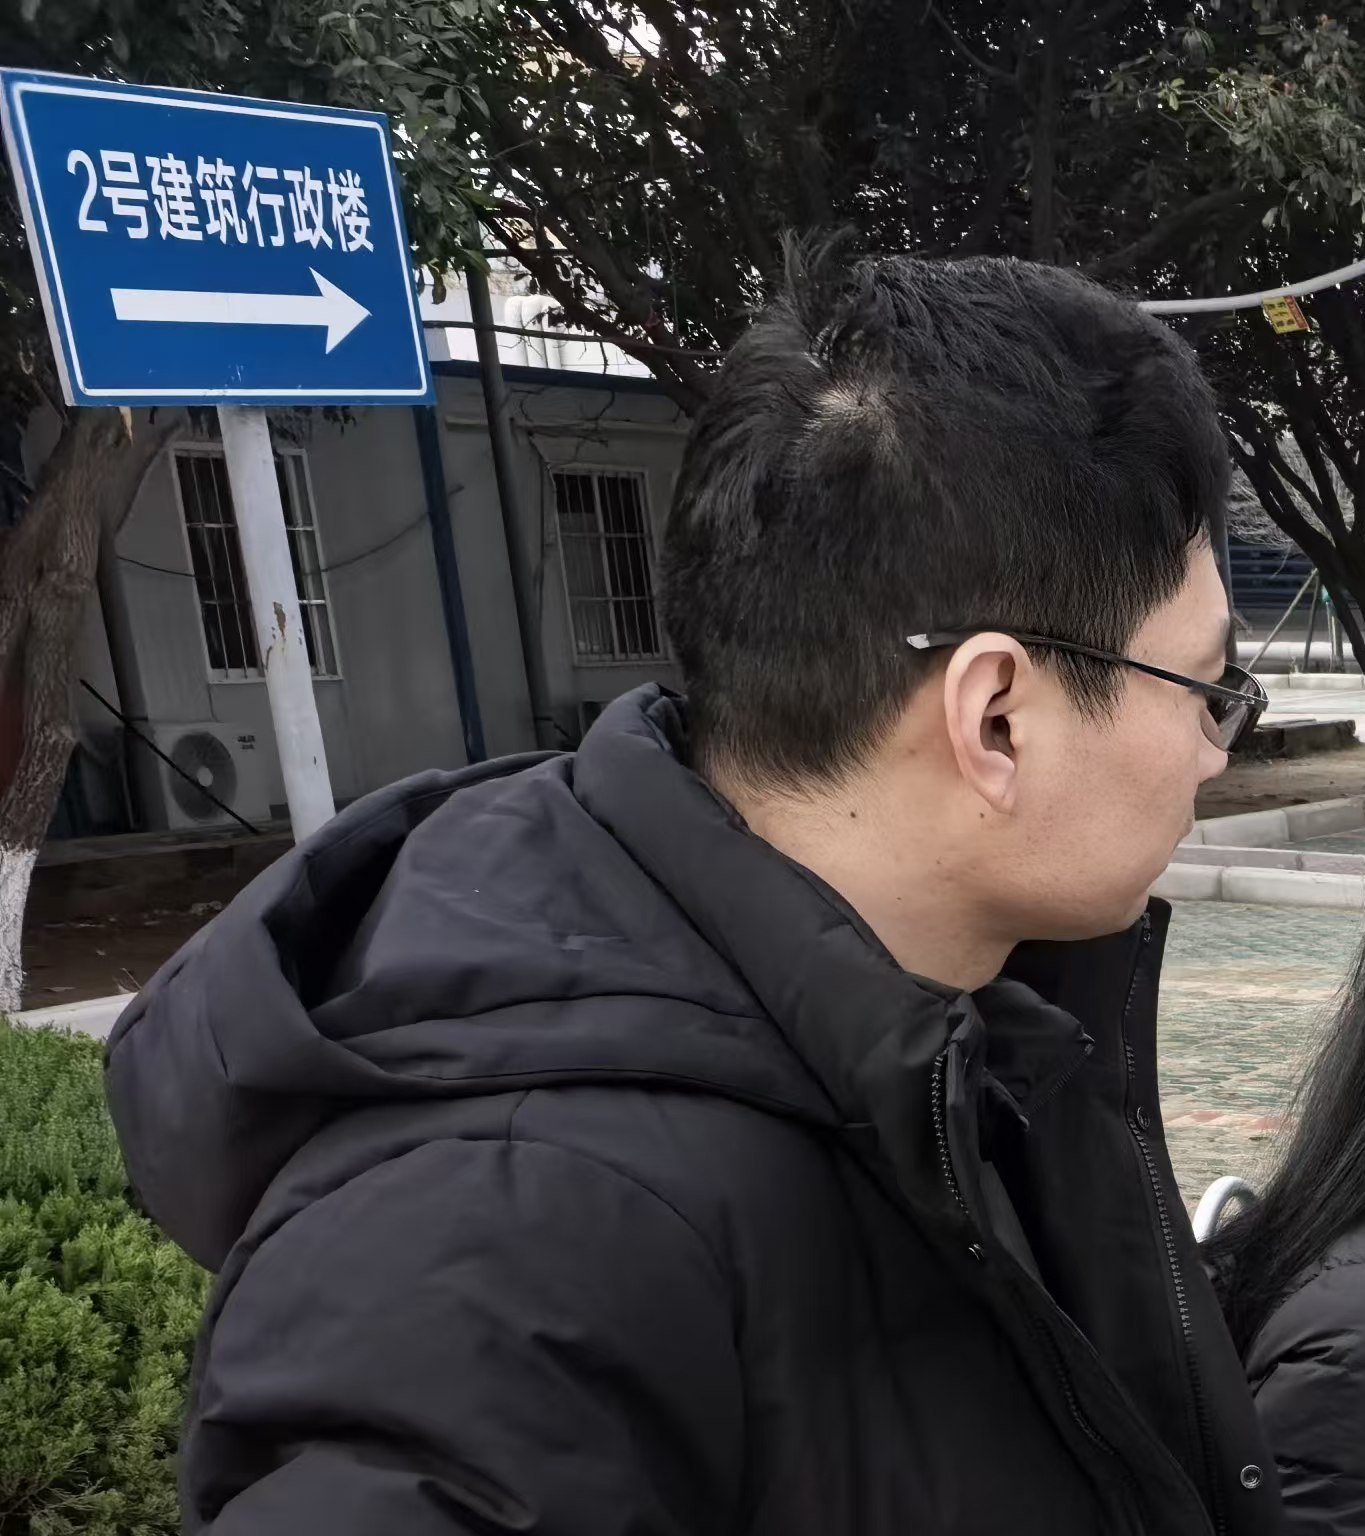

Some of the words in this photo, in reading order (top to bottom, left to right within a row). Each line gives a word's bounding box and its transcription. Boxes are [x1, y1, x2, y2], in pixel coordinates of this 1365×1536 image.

[67, 149, 374, 253] 2号建筑行政楼
